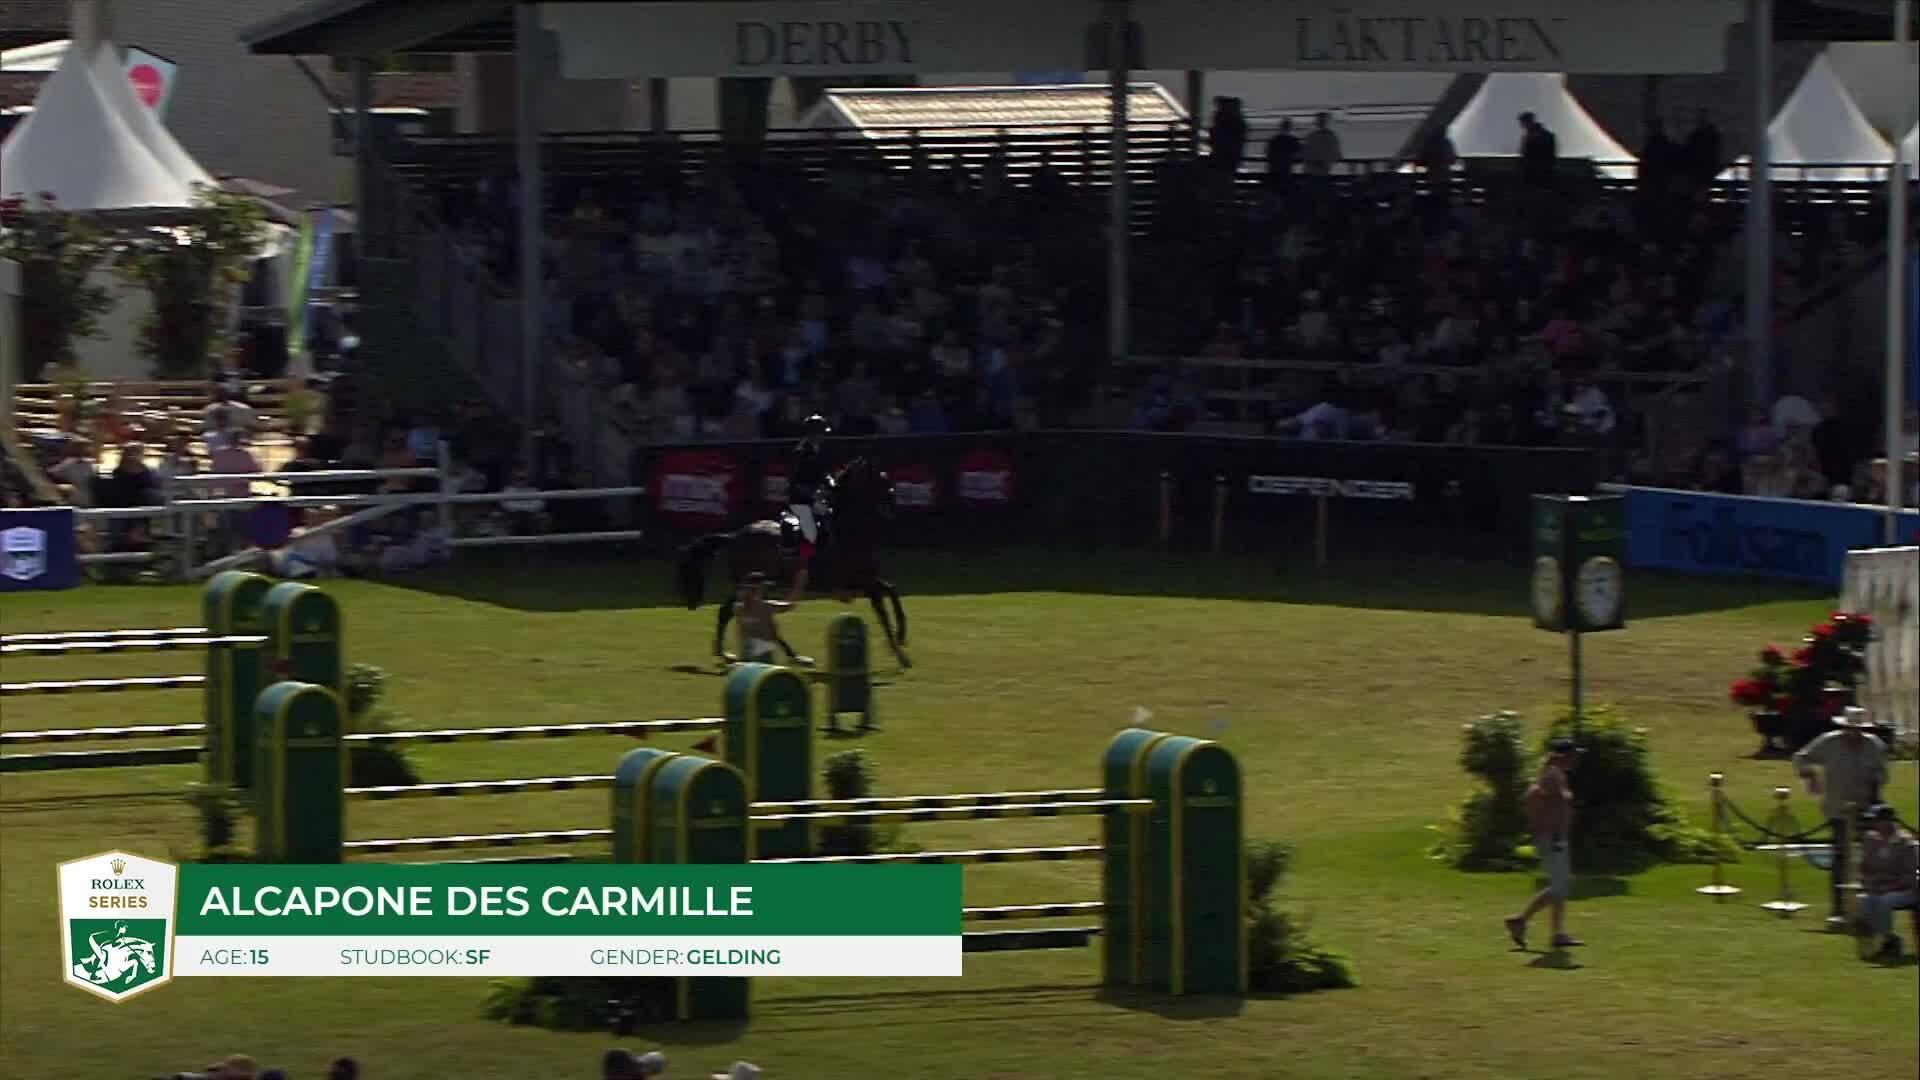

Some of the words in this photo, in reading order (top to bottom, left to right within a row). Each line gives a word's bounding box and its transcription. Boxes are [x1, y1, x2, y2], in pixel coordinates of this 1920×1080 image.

[736, 21, 918, 65] DERBY
[1295, 8, 1568, 62] LÄKTAREN
[1248, 475, 1416, 501] DEFENDER
